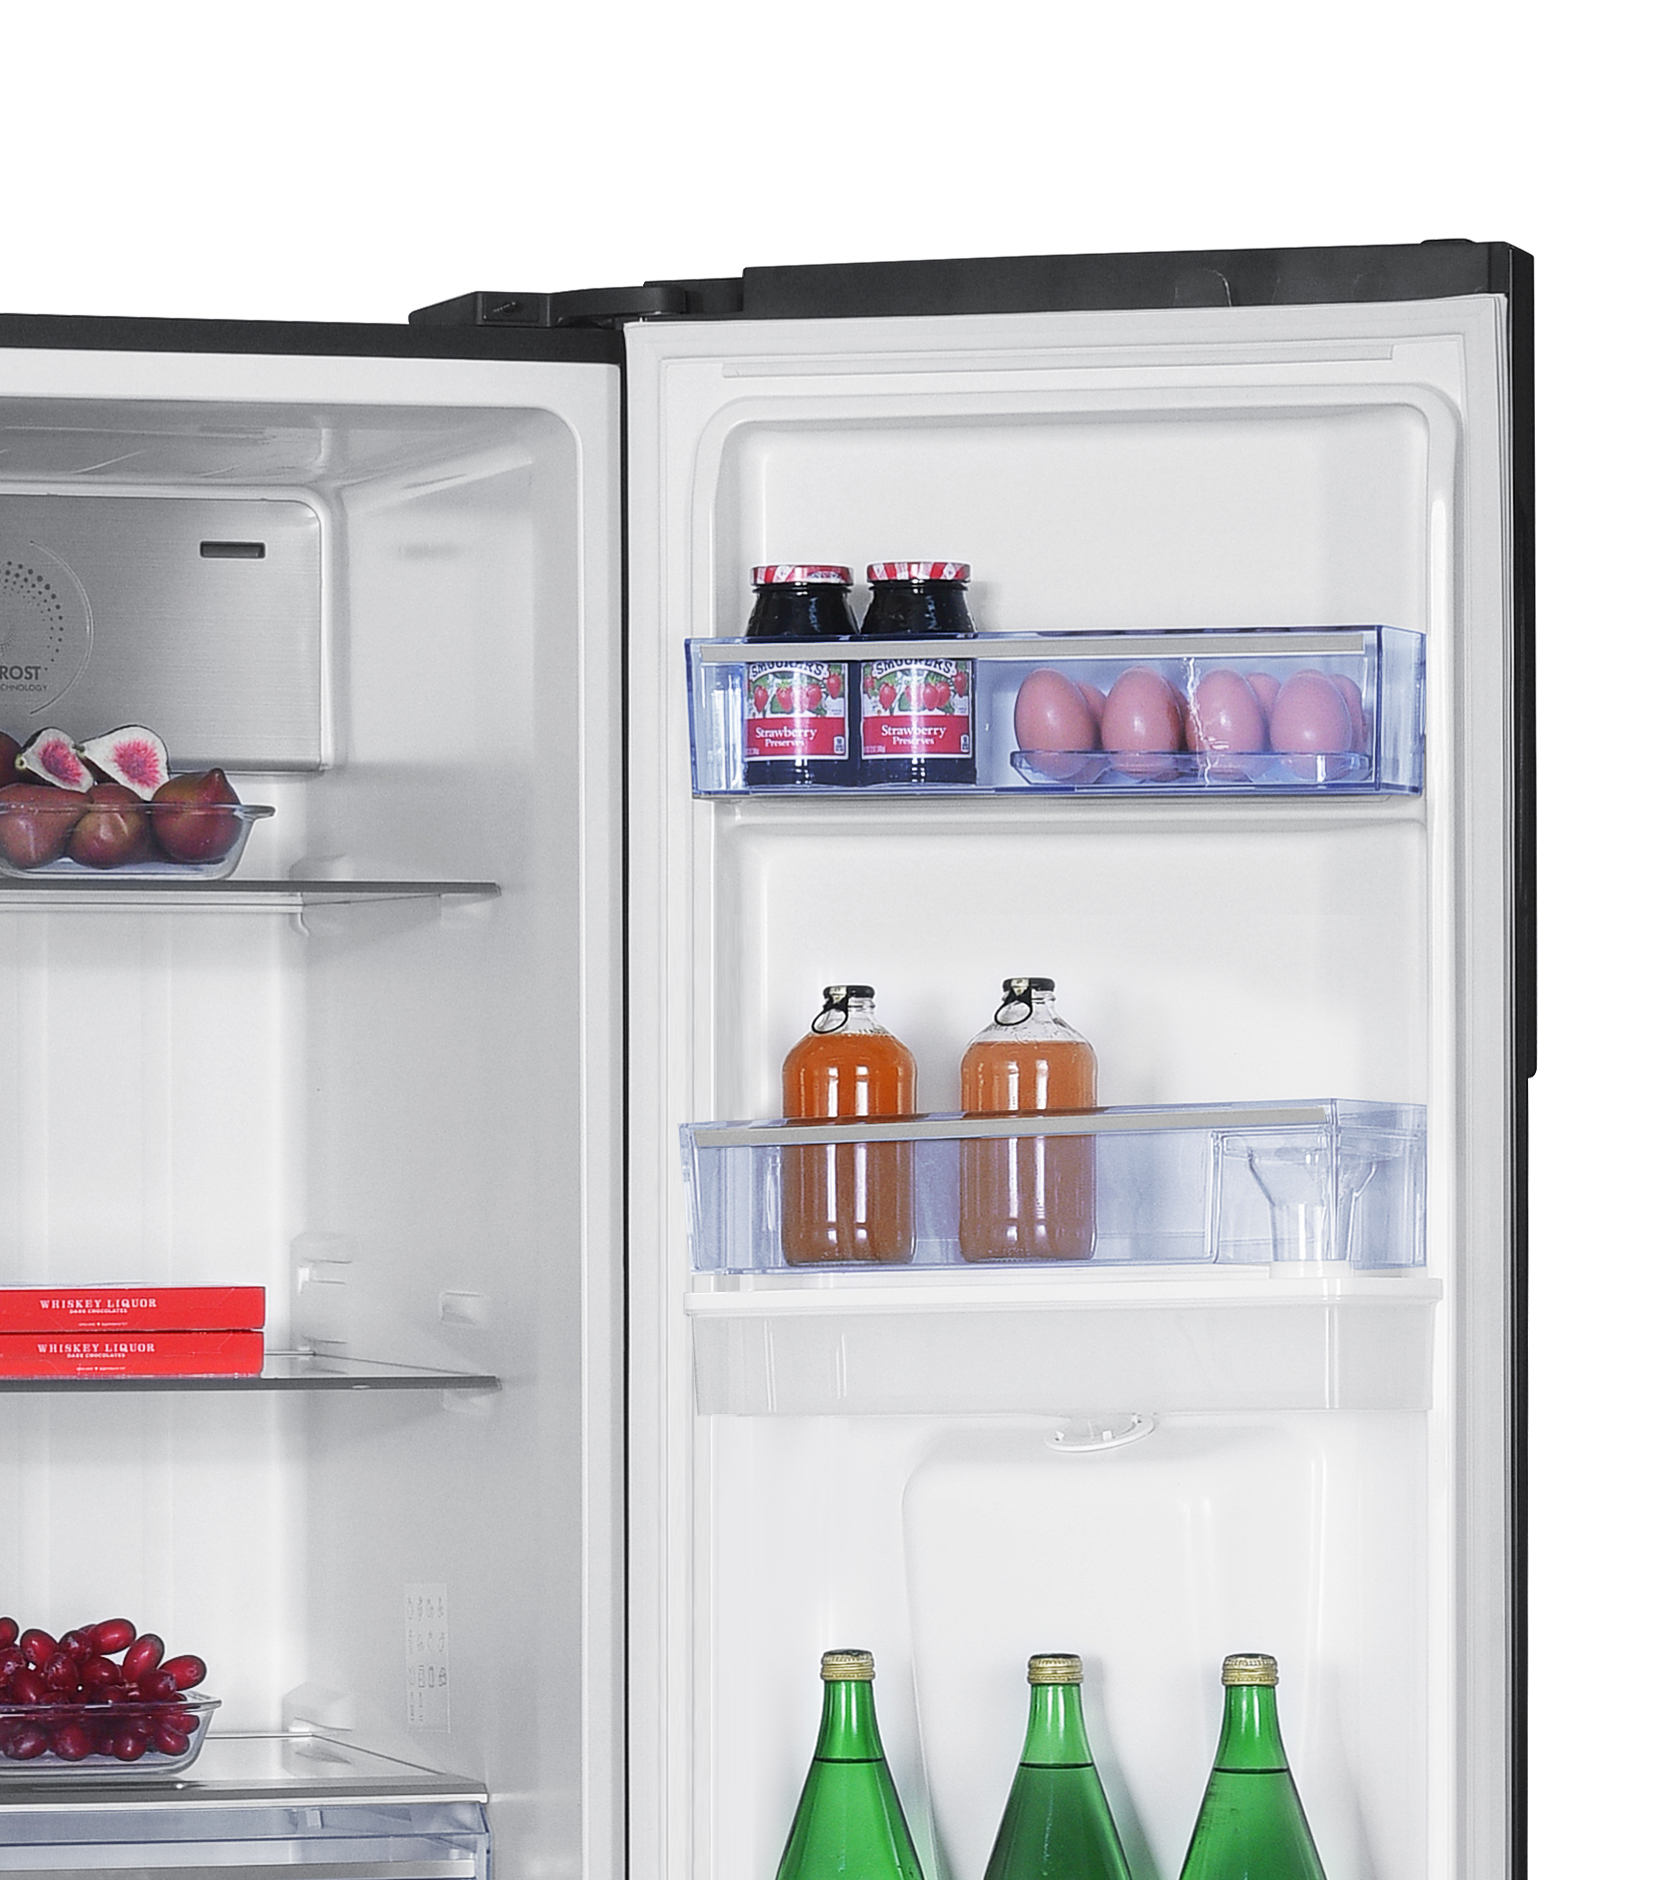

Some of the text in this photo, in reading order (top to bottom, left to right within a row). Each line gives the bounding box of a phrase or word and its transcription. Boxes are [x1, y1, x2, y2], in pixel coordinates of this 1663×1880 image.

[755, 726, 818, 741] Strawberry
[881, 724, 947, 739] Strawberry
[764, 738, 806, 749] Preserves
[892, 736, 936, 746] Preserves
[39, 1298, 157, 1309] WHISKEY LIQUOR
[37, 1343, 155, 1353] WHISKEY LIQUOR
